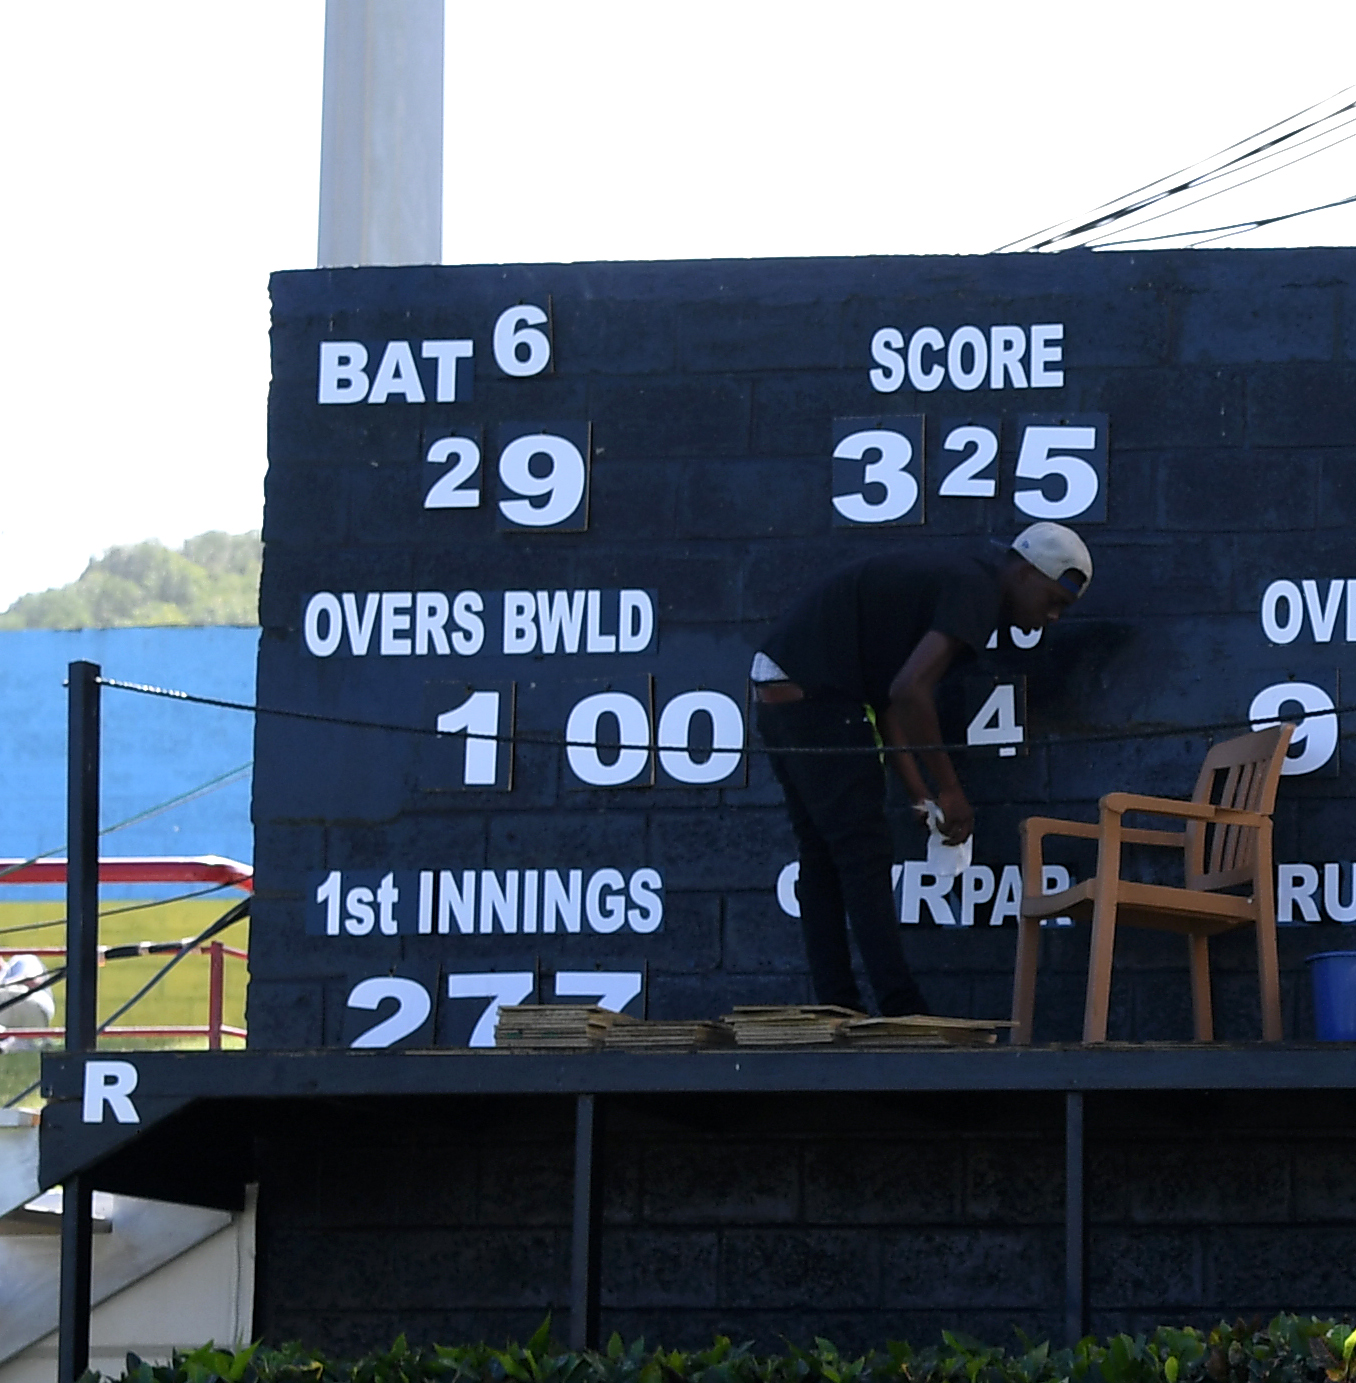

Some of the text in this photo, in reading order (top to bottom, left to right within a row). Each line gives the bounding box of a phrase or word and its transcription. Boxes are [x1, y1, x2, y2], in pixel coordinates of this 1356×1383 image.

[318, 305, 551, 404] BAT 6
[869, 323, 1065, 393] SCORE
[424, 433, 586, 526] 29
[832, 425, 1100, 524] 325
[304, 589, 654, 657] OVERS BWLD
[966, 684, 1024, 757] 4
[316, 868, 663, 936] 1st INNINGS
[82, 1061, 140, 1123] R
